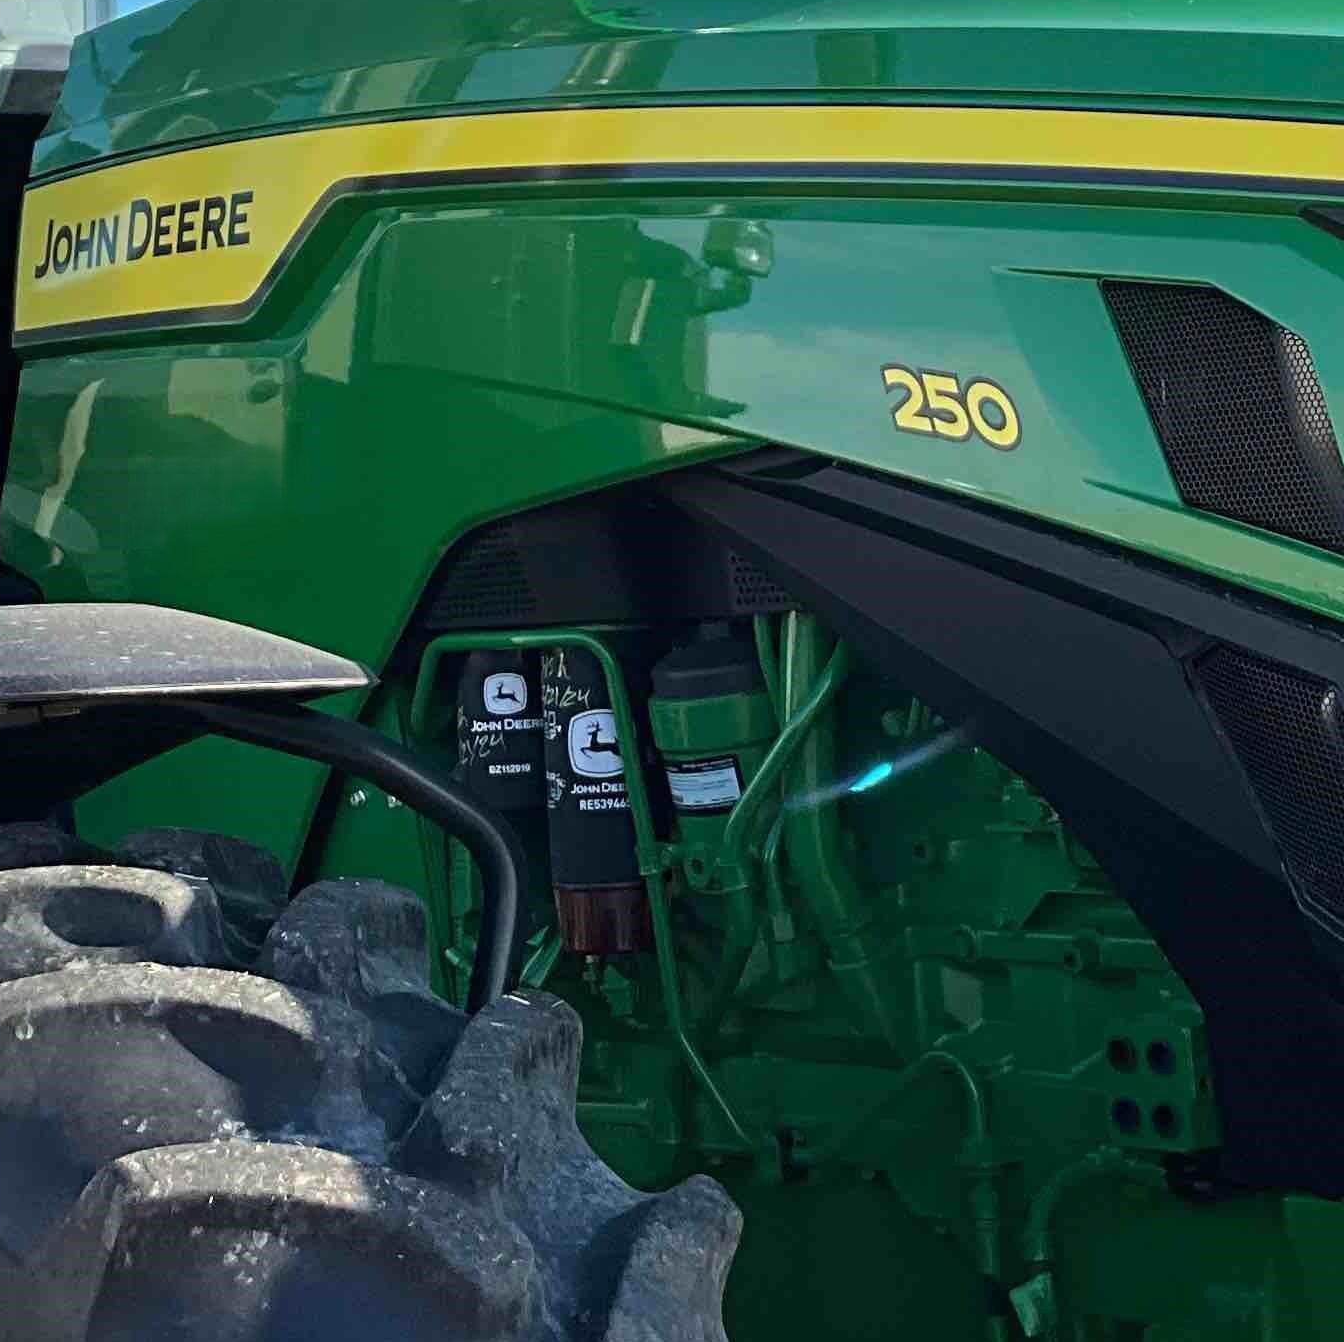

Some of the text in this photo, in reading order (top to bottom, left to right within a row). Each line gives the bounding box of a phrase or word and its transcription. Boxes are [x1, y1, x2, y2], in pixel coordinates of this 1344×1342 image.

[34, 190, 254, 279] JOHN DEERE
[881, 364, 1021, 450] 250
[470, 718, 544, 732] JOHN DEER
[570, 782, 625, 794] JOHN DEE
